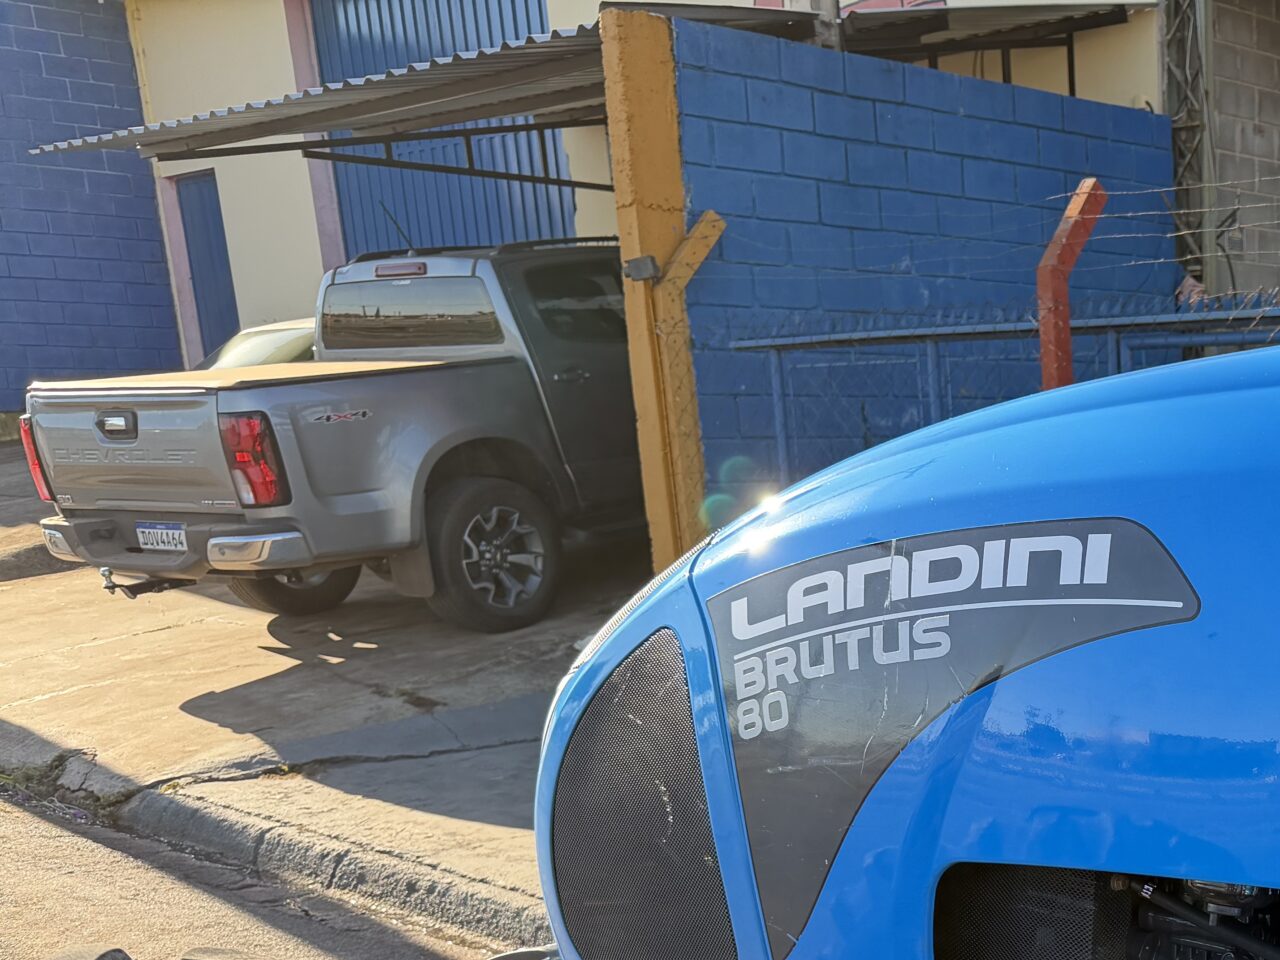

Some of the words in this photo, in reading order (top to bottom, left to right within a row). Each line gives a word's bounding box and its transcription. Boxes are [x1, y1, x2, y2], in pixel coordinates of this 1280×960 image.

[53, 448, 197, 464] CHEVROLET
[730, 533, 1112, 641] LANDINI
[734, 613, 950, 701] BRUTUS
[737, 690, 790, 741] 80
